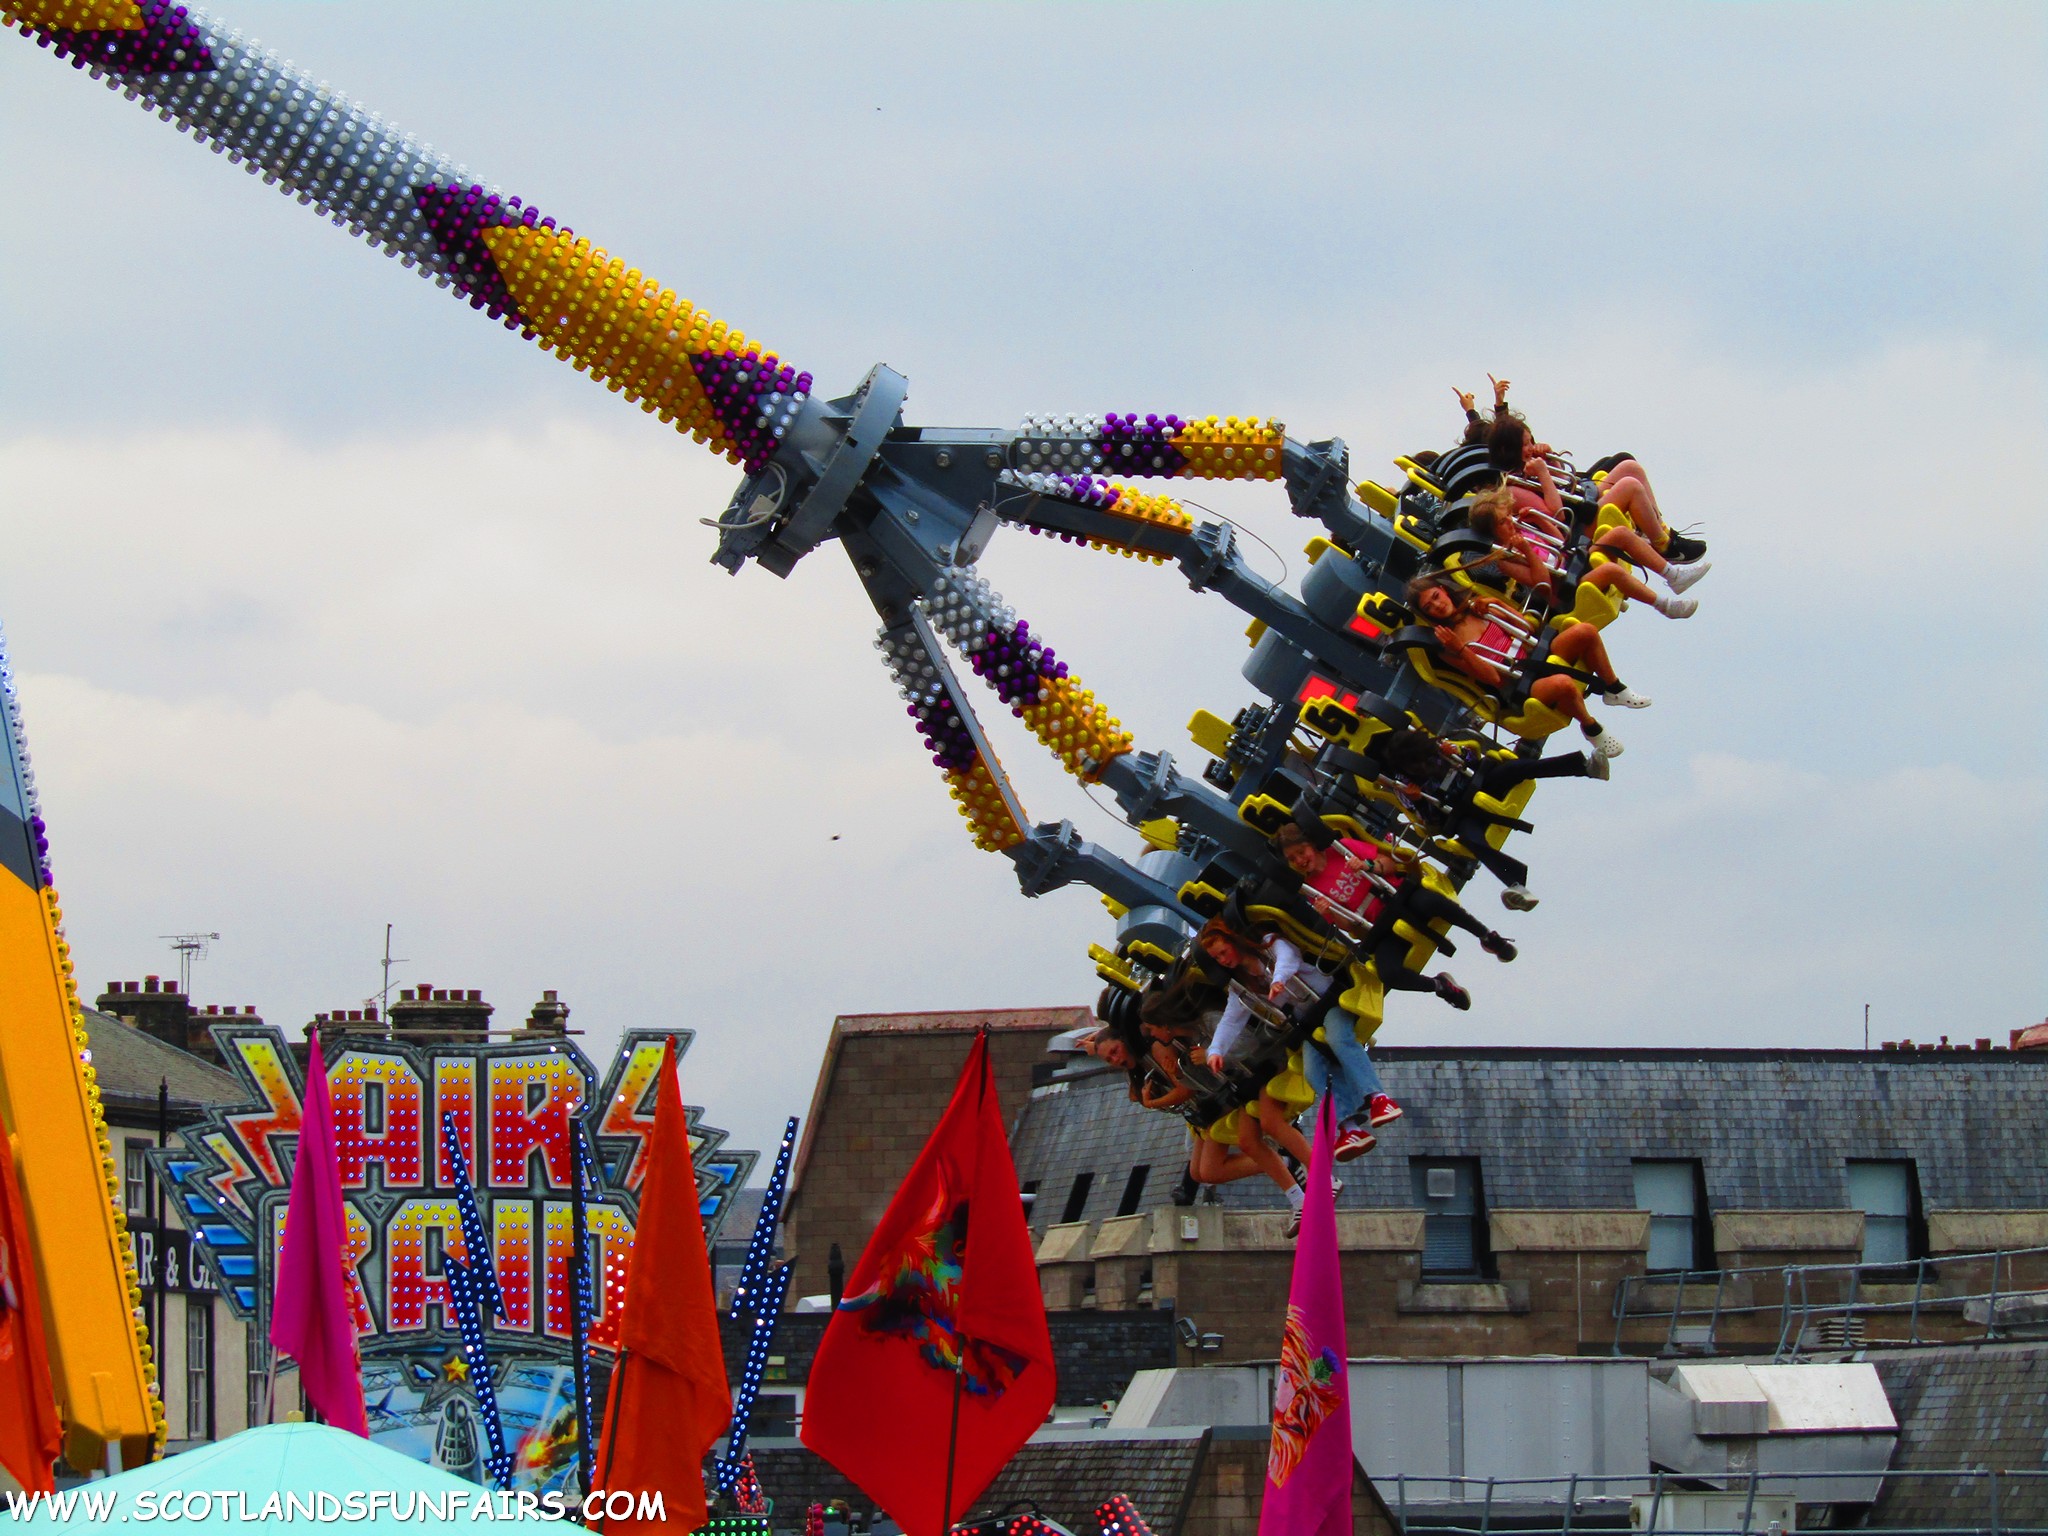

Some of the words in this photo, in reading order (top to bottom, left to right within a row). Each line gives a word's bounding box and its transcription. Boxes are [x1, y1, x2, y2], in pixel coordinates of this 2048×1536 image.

[1330, 868, 1352, 898] SAL
[325, 1051, 592, 1190] AIR
[166, 1246, 180, 1288] &
